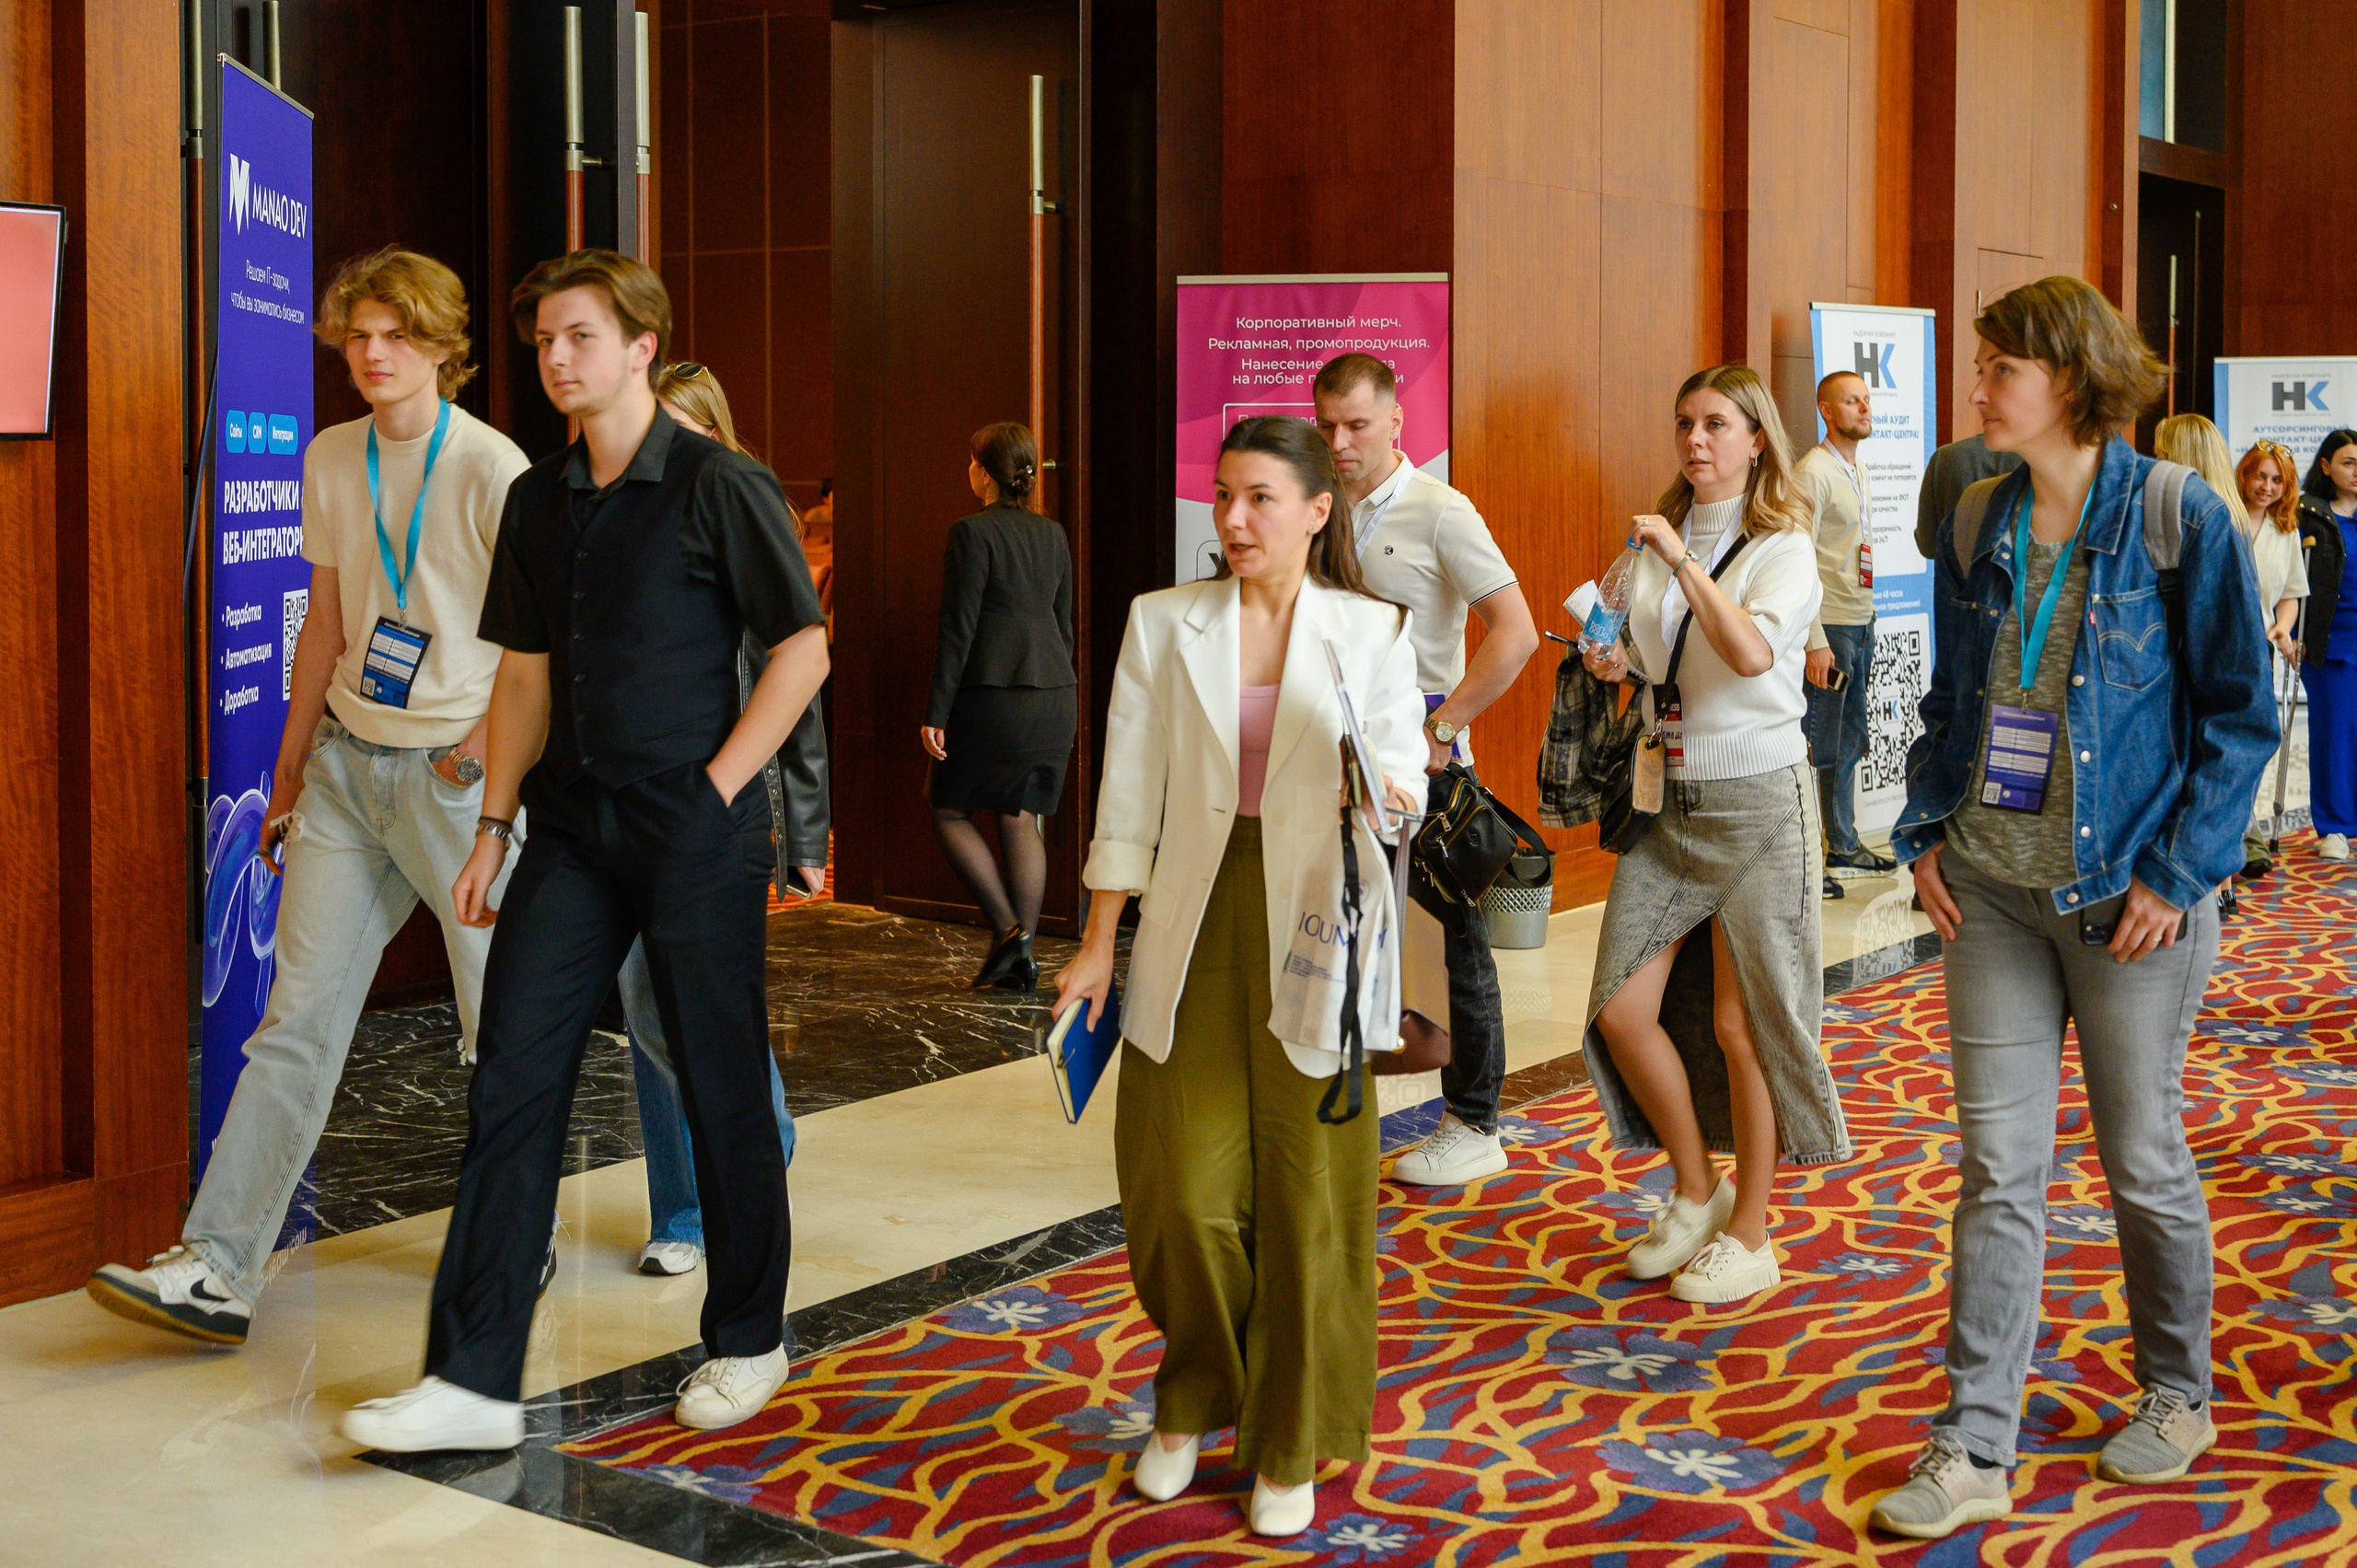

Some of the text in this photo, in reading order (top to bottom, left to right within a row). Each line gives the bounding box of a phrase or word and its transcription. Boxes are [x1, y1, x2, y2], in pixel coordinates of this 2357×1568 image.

[252, 181, 308, 238] MANAO DEV
[246, 260, 266, 283] Решаем
[231, 290, 305, 324] чтобы вы занимались бизнесом
[1236, 316, 1401, 331] Корпоративный мерч.
[1208, 337, 1430, 352] Рекламная, промопродукция.
[1242, 358, 1324, 370] Нанесение
[1233, 374, 1250, 385] на
[1253, 371, 1304, 385] любые
[1871, 412, 1910, 425] ТНЫЙ АУДИТ
[229, 424, 242, 438] Сайты
[252, 424, 262, 439] CRM
[272, 425, 295, 443] Интеграции
[1868, 429, 1920, 440] ОНТАКТ-ЦЕНТРА!
[1865, 462, 1887, 471] бработка
[224, 480, 299, 514] РАЗРАБОТЧИКИ
[226, 602, 262, 631] Разработка
[225, 643, 273, 670] Автоматизация
[224, 684, 260, 715] Доработка
